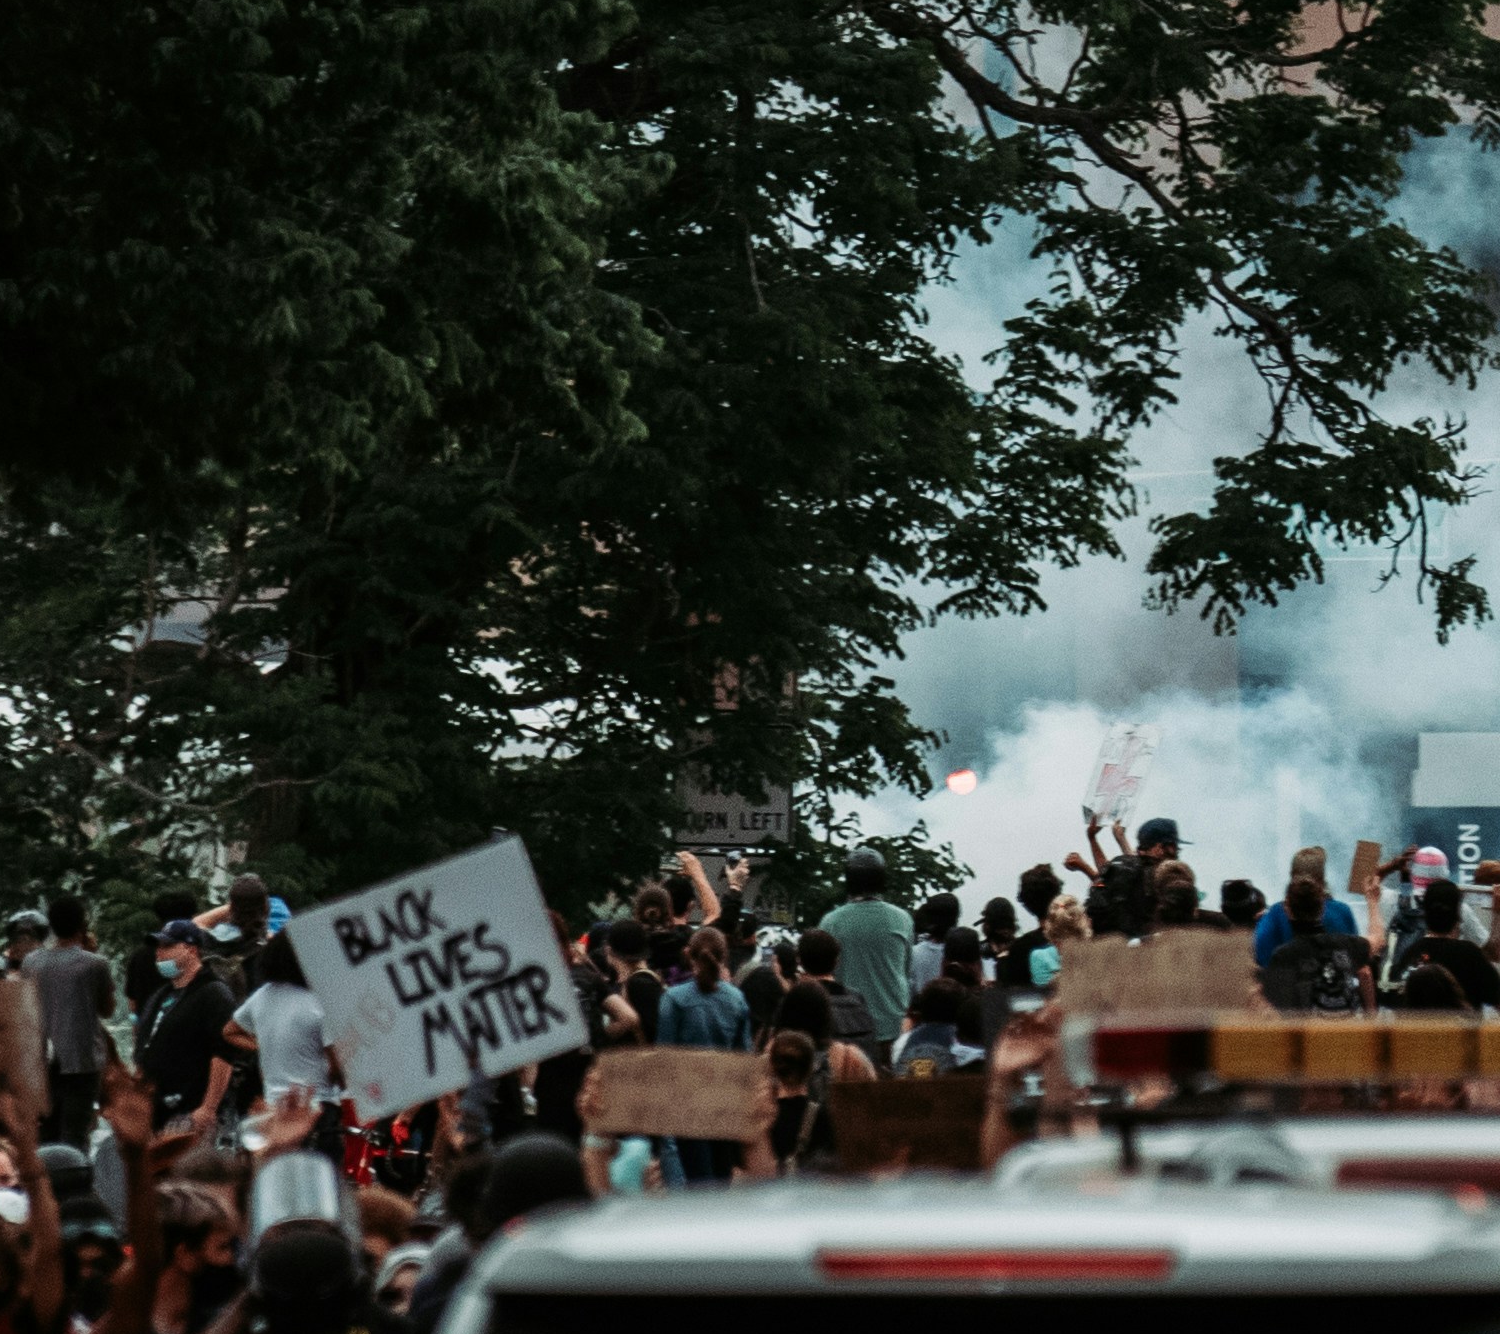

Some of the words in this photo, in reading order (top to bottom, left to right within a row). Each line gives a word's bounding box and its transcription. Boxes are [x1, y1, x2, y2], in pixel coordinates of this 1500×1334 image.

[740, 812, 786, 831] LEFT
[332, 887, 448, 967] BLACK
[384, 922, 511, 1007] LIVES
[421, 963, 568, 1078] MATTER
